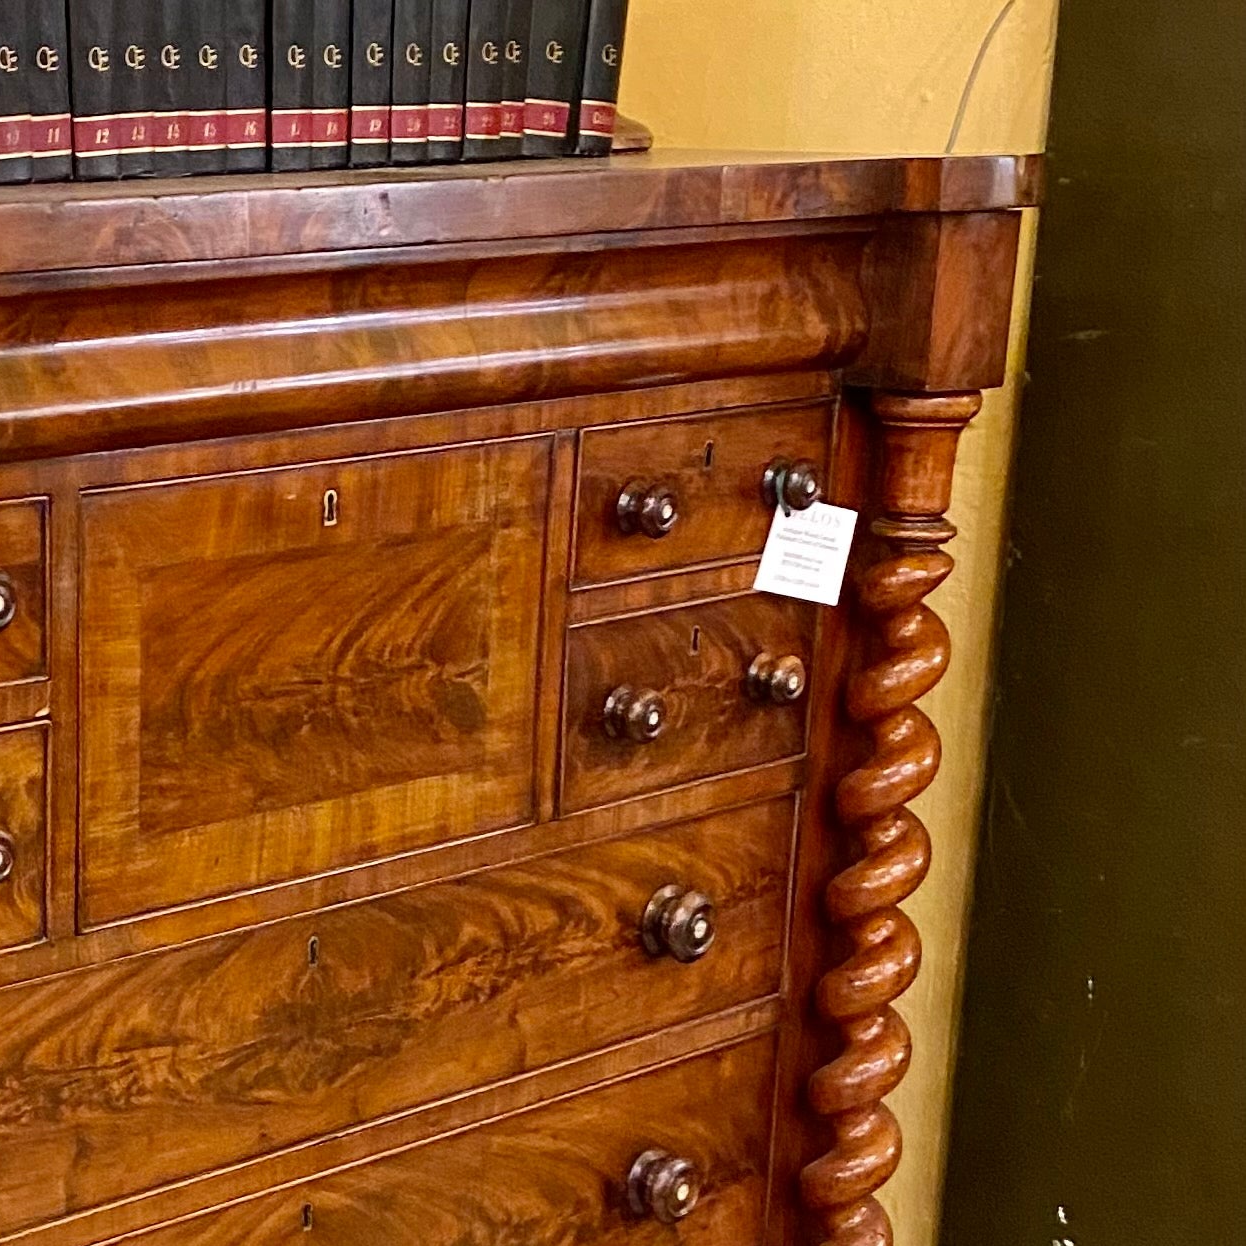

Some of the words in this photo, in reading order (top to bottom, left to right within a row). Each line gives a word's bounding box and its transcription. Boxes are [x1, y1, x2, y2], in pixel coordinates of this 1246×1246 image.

[47, 127, 60, 144] 11
[95, 128, 110, 144] 12
[131, 125, 146, 141] 13
[203, 122, 217, 138] 15
[243, 120, 257, 136] 16
